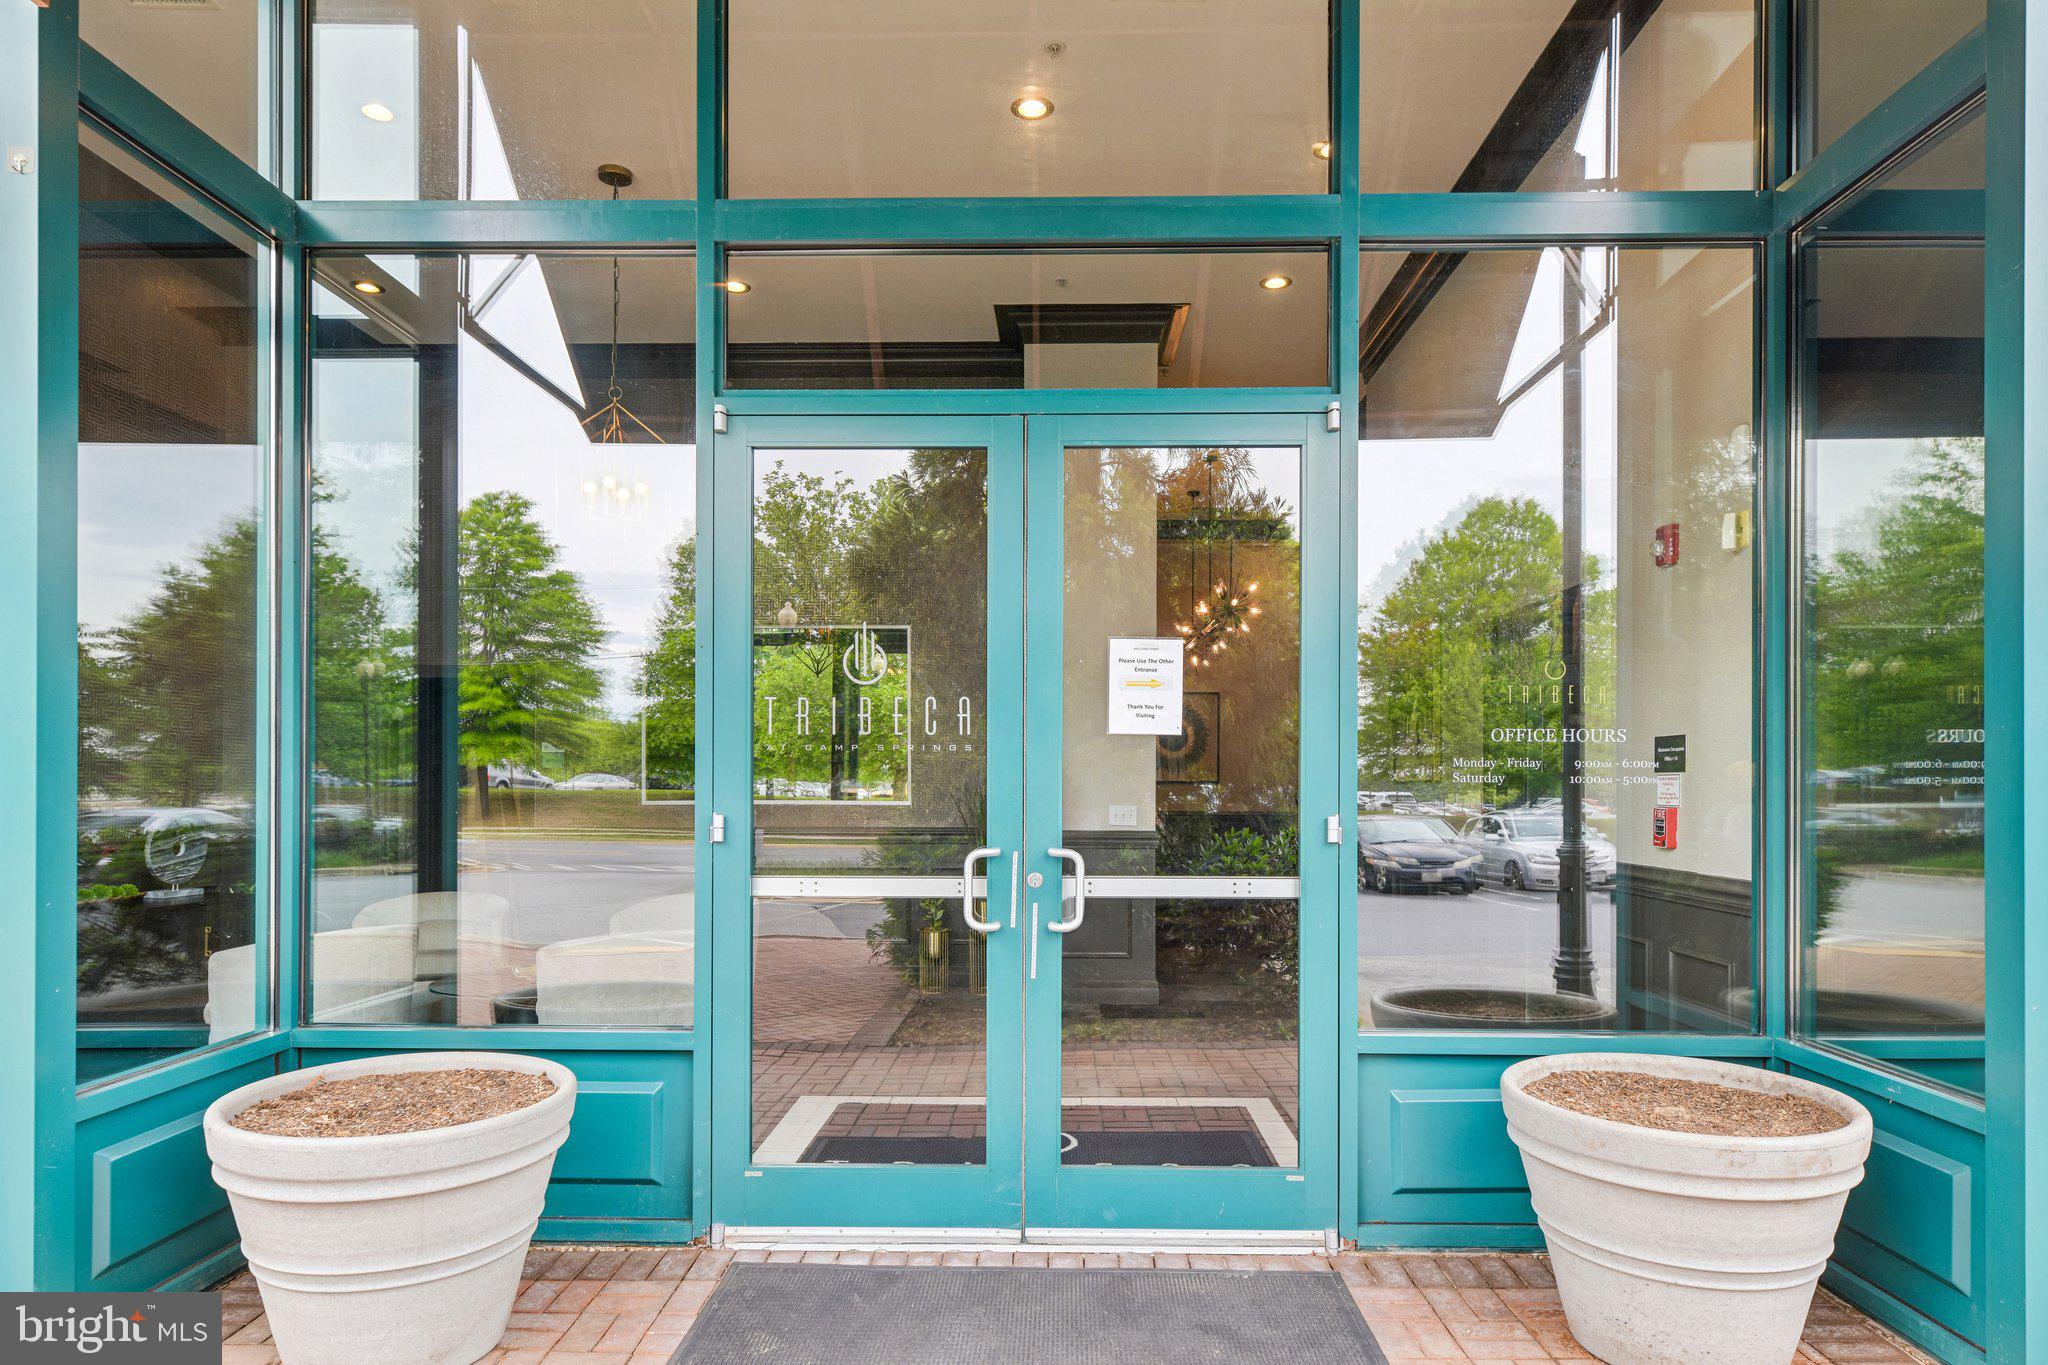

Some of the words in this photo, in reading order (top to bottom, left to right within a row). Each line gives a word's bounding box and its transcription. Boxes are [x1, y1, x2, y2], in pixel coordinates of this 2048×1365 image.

[1507, 685, 1606, 704] TRIBECA
[764, 696, 971, 735] TRIBECA
[1491, 728, 1557, 742] OFFICE
[1562, 728, 1627, 743] HOURS
[1452, 757, 1497, 770] Monday
[1507, 757, 1542, 770] Friday
[1452, 772, 1505, 785] Saturday
